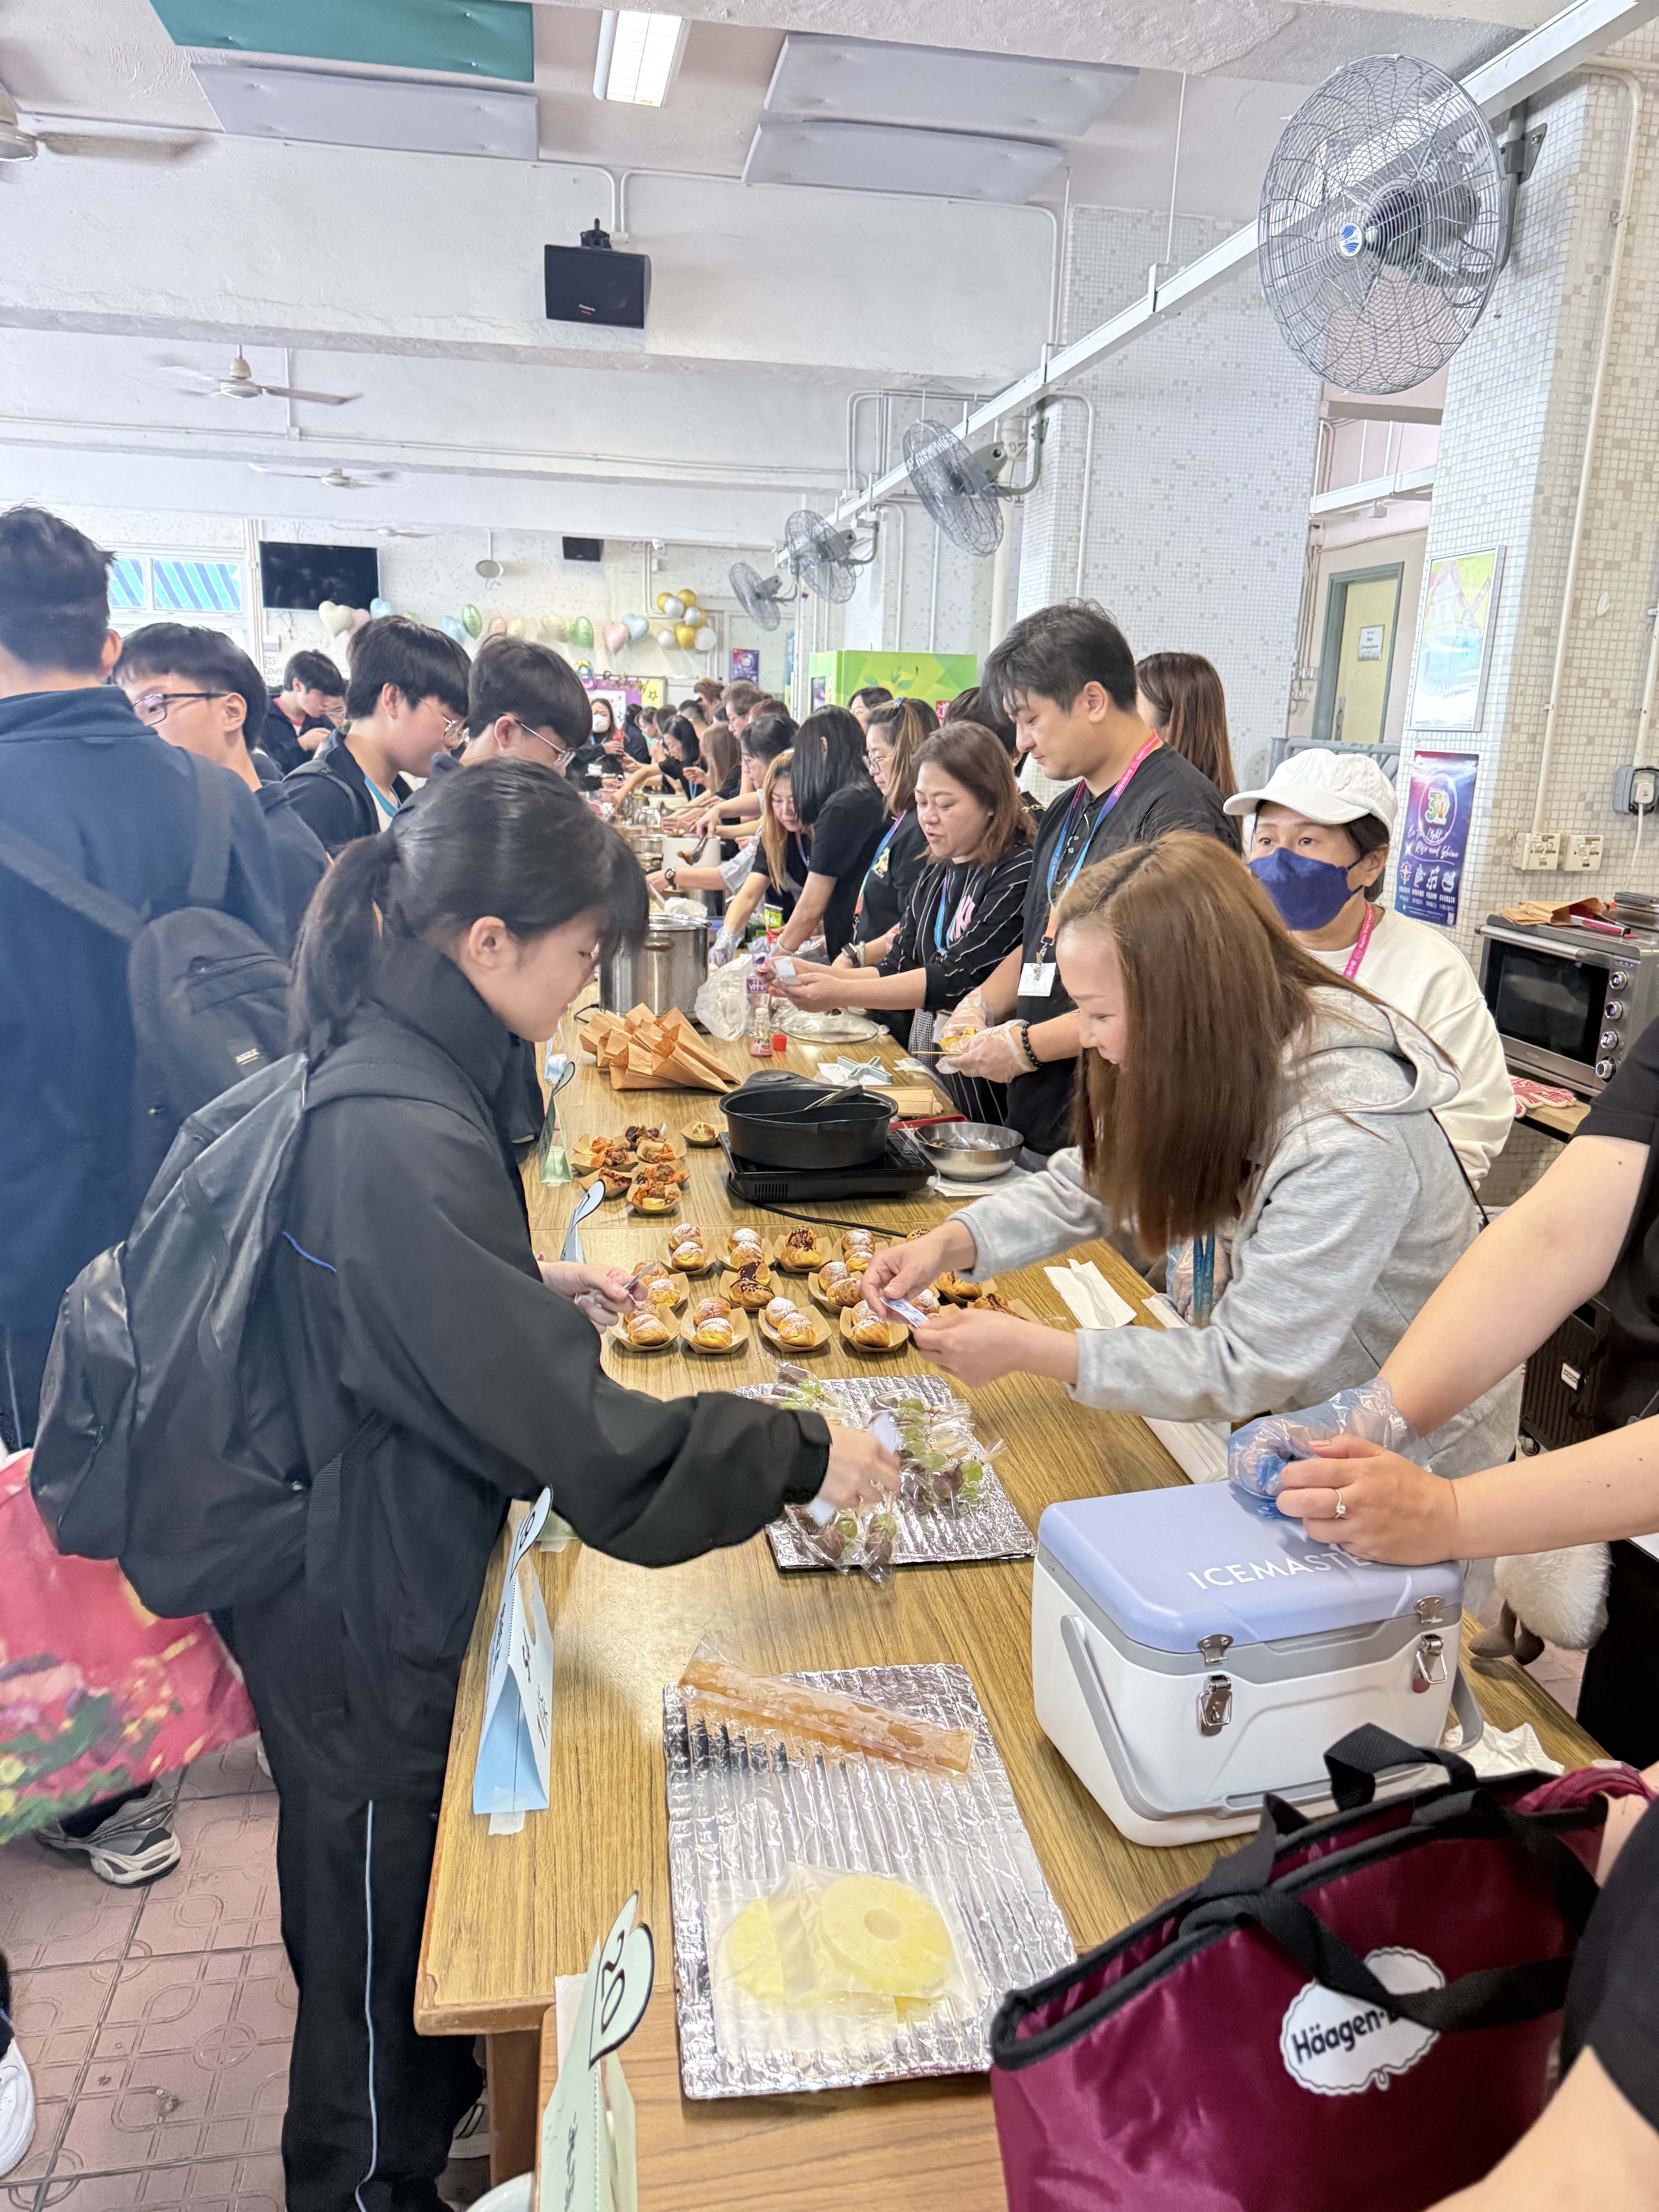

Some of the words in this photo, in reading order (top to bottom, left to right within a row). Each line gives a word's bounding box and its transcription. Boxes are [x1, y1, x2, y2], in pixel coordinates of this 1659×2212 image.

[1187, 1550, 1372, 1590] ICEMASTE
[601, 1929, 625, 2035] 20
[1291, 2008, 1401, 2065] Häagen-
